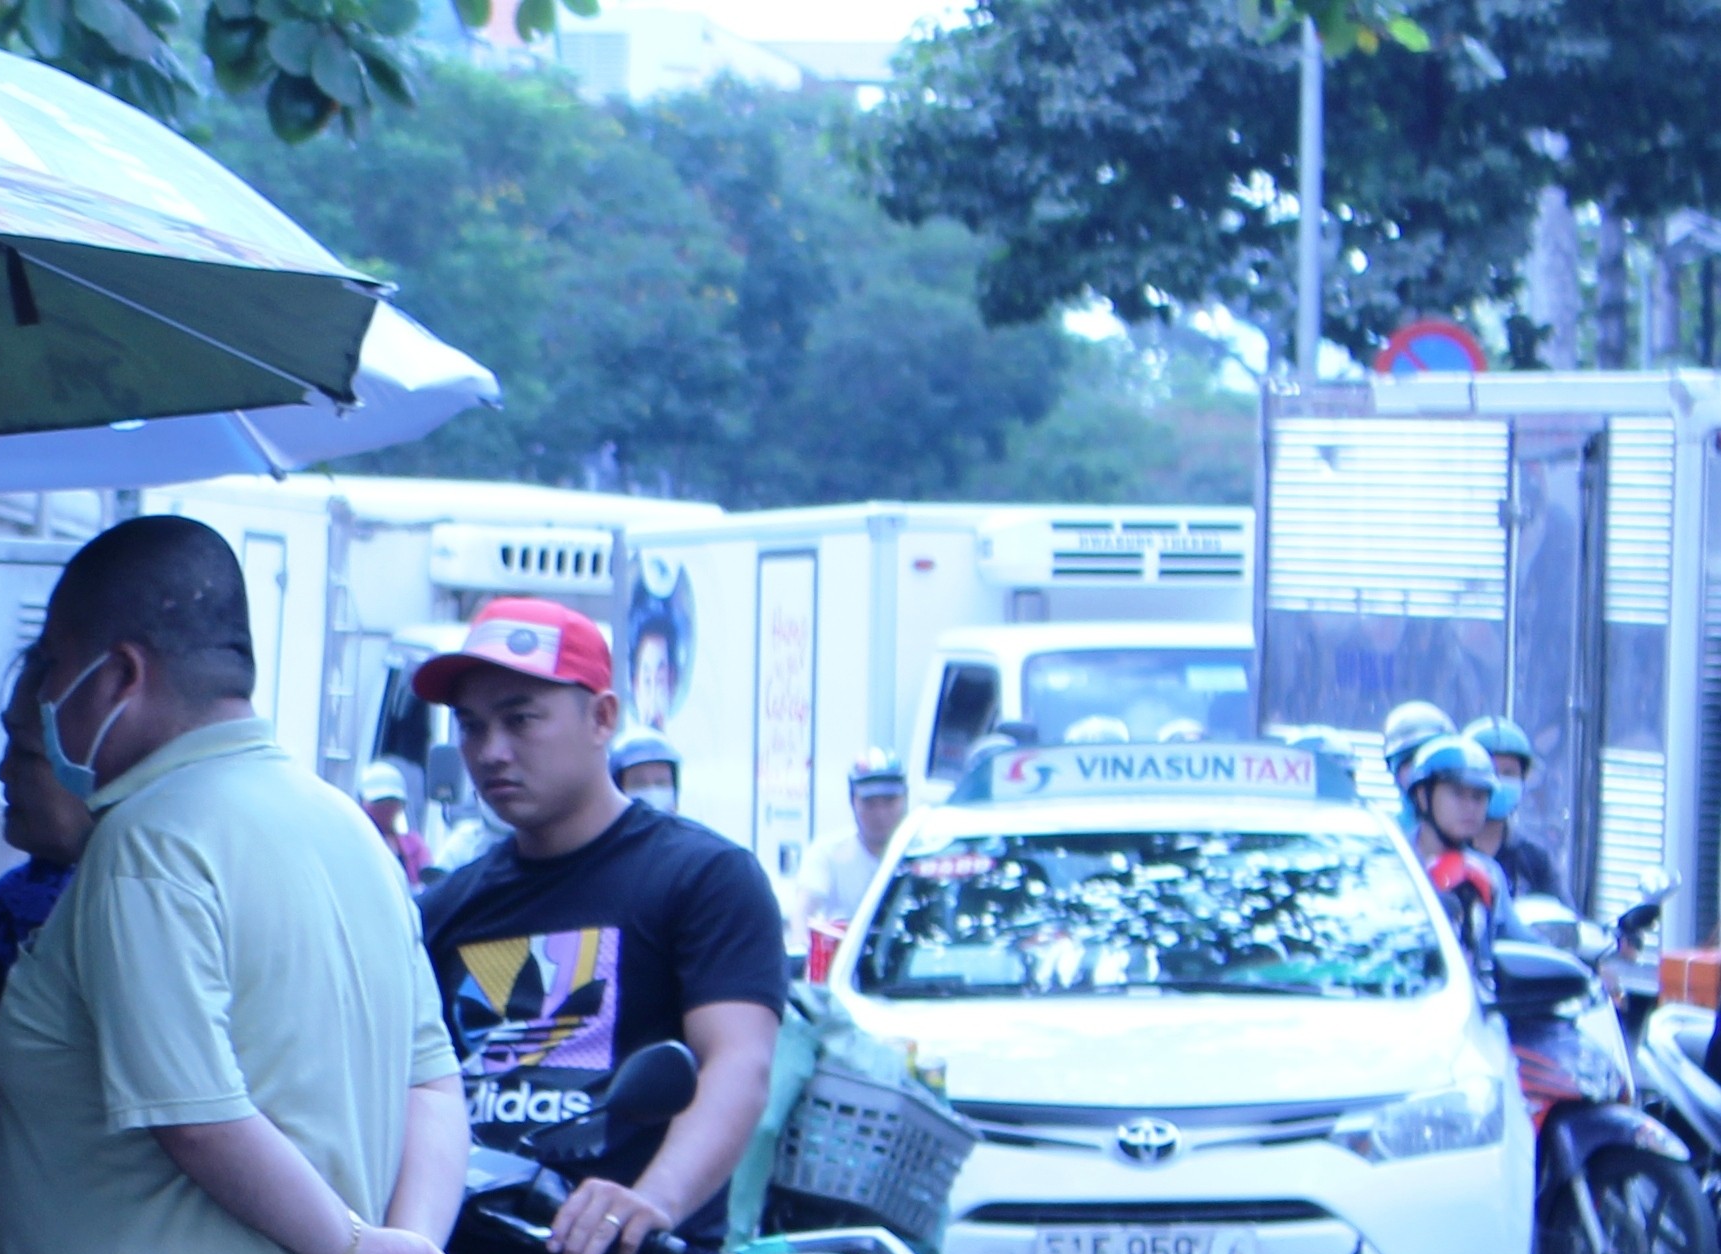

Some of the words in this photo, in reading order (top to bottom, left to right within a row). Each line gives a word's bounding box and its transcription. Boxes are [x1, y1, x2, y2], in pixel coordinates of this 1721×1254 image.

[1075, 755, 1236, 782] VINASUN
[1241, 756, 1313, 785] TAXI
[467, 1081, 593, 1124] didas
